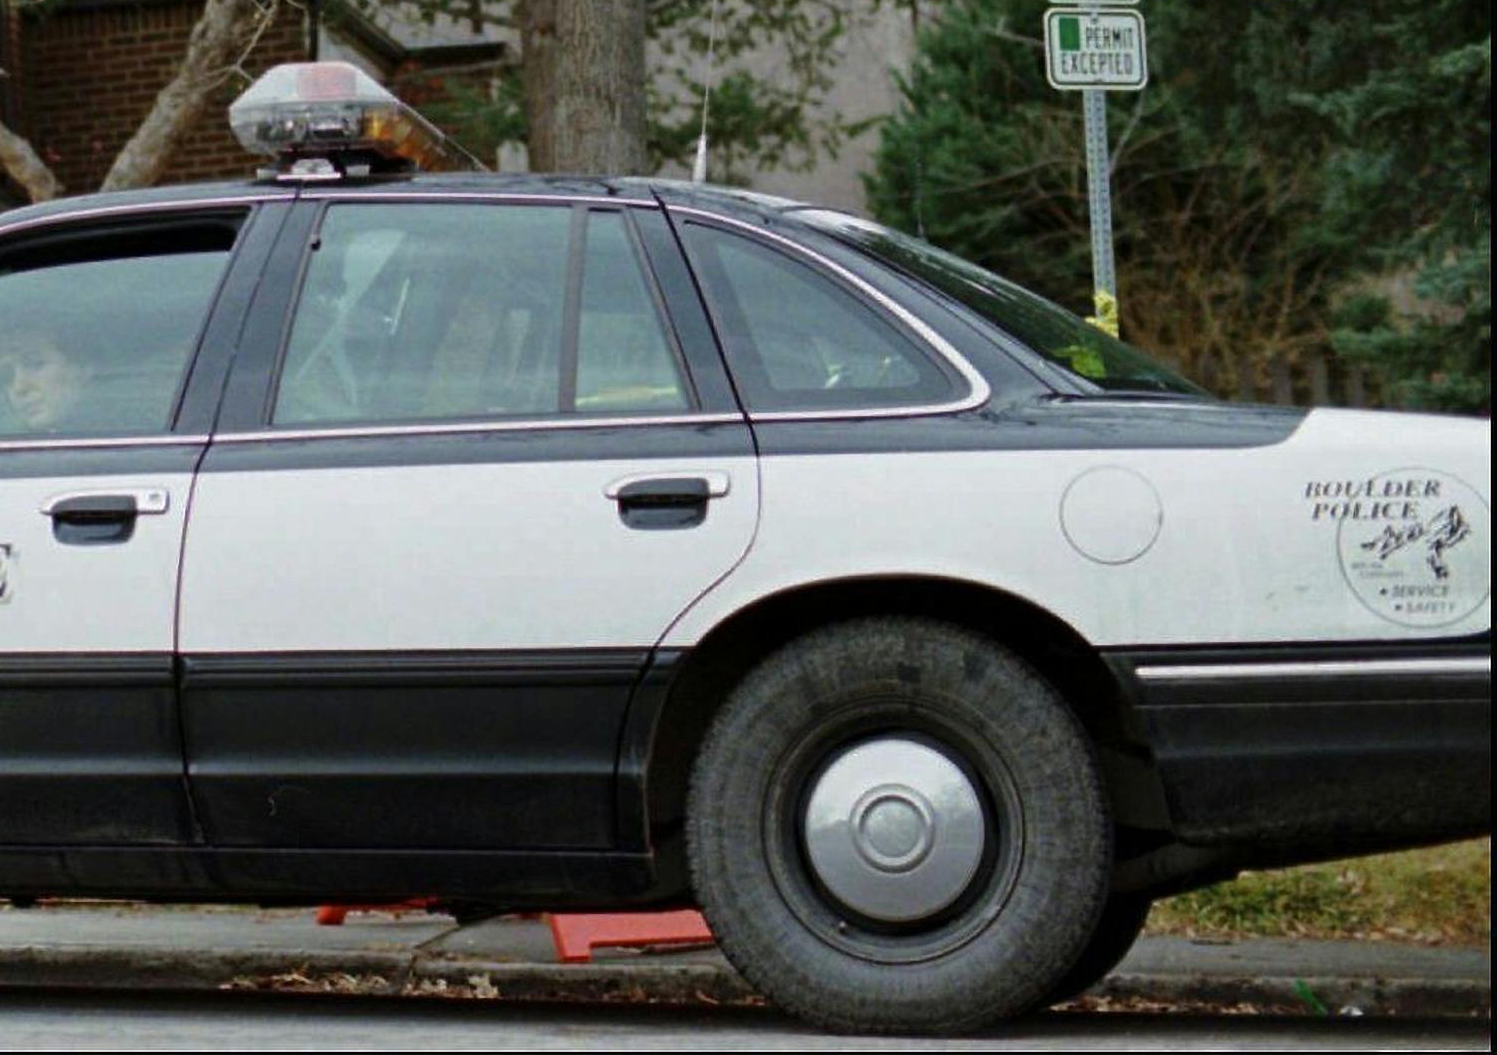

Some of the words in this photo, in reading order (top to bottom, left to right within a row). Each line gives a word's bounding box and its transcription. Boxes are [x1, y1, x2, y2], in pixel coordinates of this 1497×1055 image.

[1085, 27, 1133, 50] PERMIT
[1061, 52, 1134, 75] EXCEPTED
[1305, 479, 1441, 498] BOULDER
[1312, 501, 1419, 521] POLICE
[1391, 584, 1450, 599] SERVICE
